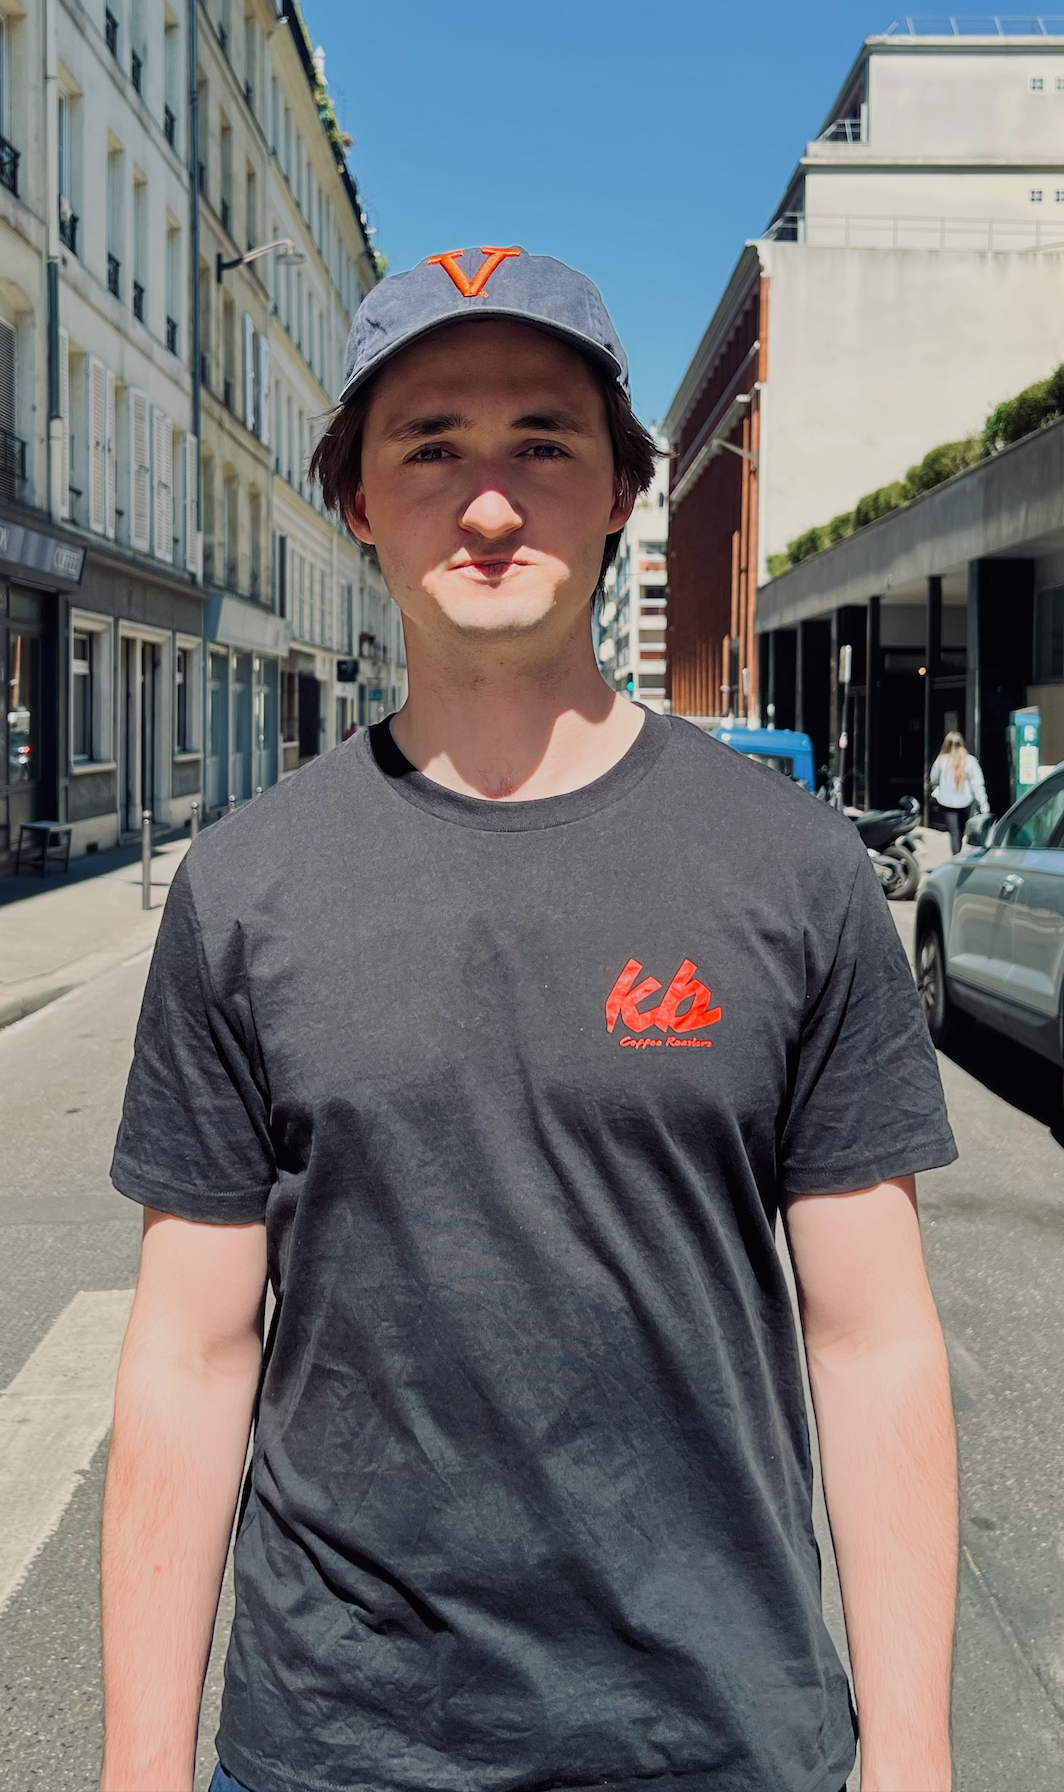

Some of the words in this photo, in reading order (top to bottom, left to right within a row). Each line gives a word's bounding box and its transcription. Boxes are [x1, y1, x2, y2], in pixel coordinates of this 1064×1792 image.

[427, 247, 520, 297] V
[620, 1036, 662, 1048] Coffee
[665, 1035, 712, 1047] Roasters
